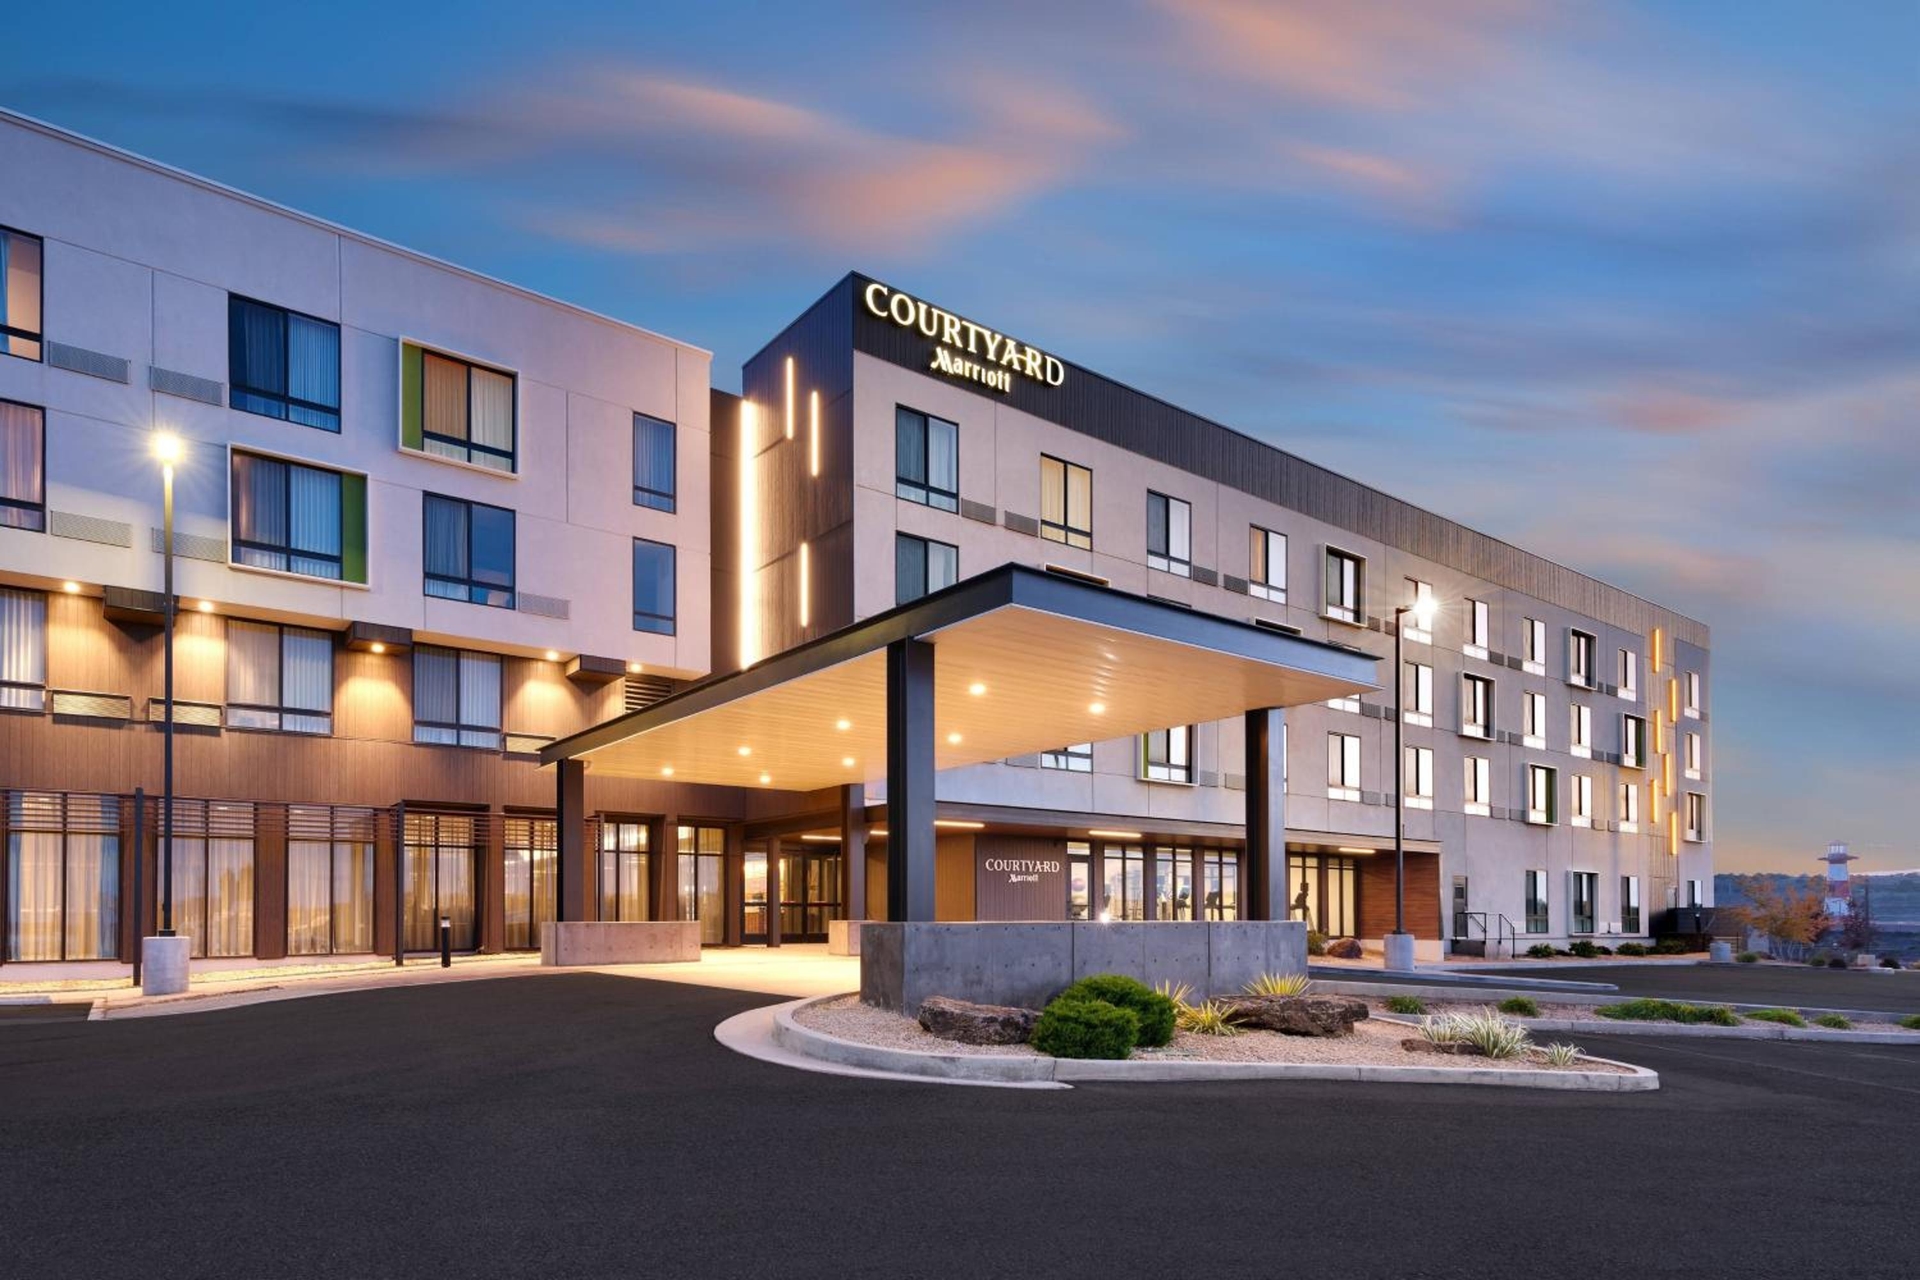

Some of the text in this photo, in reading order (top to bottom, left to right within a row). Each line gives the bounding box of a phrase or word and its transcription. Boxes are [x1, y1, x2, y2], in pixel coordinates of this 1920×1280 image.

[865, 283, 1065, 387] COURTYARD
[930, 347, 1011, 393] Marriott
[985, 858, 1060, 873] COURTYARD
[1008, 873, 1039, 883] Marriott
